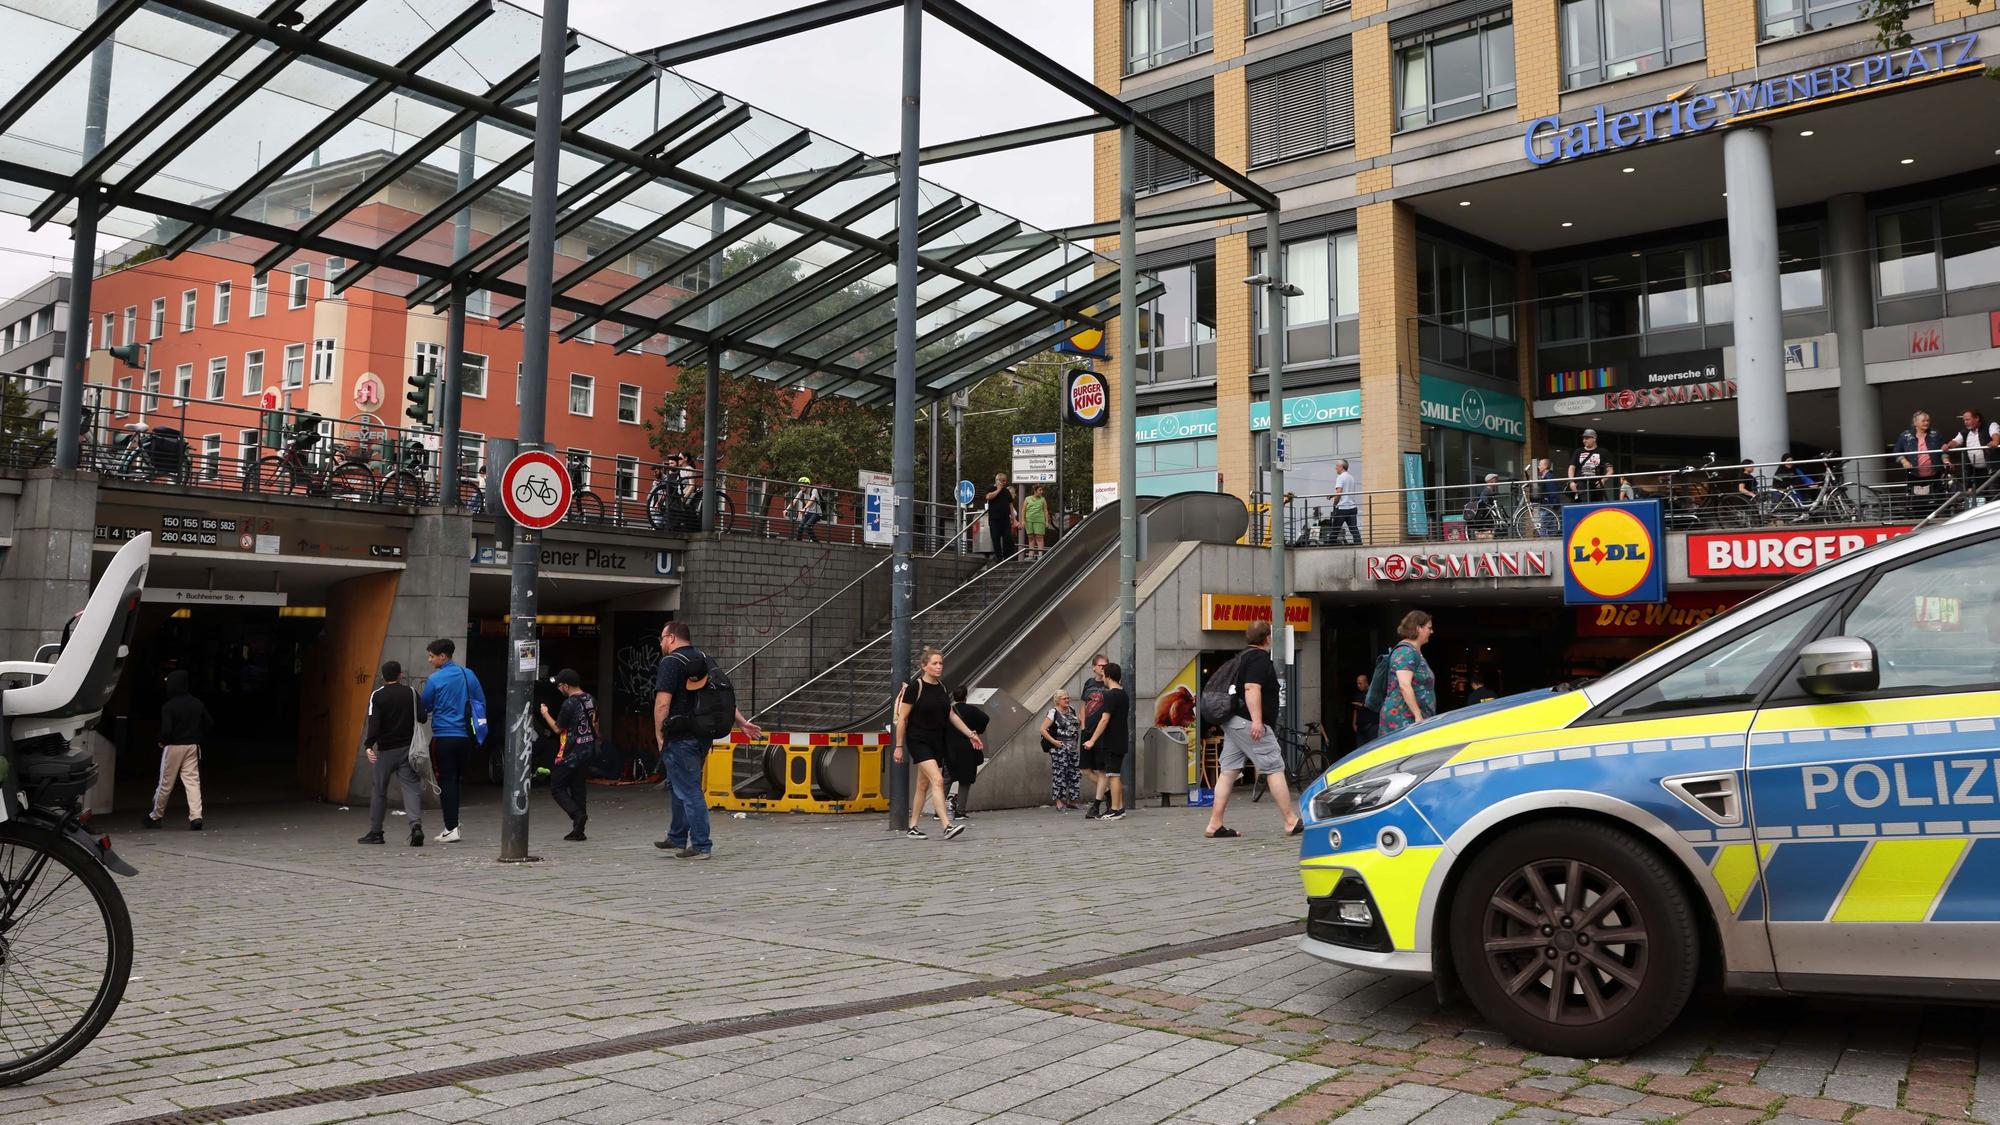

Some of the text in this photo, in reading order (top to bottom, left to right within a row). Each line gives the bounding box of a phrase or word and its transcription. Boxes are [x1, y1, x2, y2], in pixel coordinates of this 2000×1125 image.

[1524, 33, 1981, 165] Galerie WIENER PLATZ
[1649, 370, 1700, 384] Mayersche
[1073, 384, 1101, 397] BURGER
[1604, 379, 1737, 410] ROSSMANN
[1074, 393, 1102, 411] KING
[1253, 405, 1360, 428] SME OPTIC
[1420, 400, 1523, 437] SMILE OPTIC
[1179, 422, 1217, 436] OPTIC
[112, 530, 120, 538] 4
[125, 529, 136, 539] 13
[163, 517, 179, 527] 150
[183, 519, 198, 528] 155
[202, 520, 217, 529] 156
[161, 532, 216, 544] 260 434 N26
[540, 548, 626, 570] ener Platz
[657, 552, 672, 574] U
[1707, 535, 1865, 571] BURGER
[1367, 551, 1547, 582] ROSSMANN
[1213, 603, 1232, 621] DIE
[1596, 604, 1640, 626] Die
[1802, 759, 2000, 810] POLIZ
